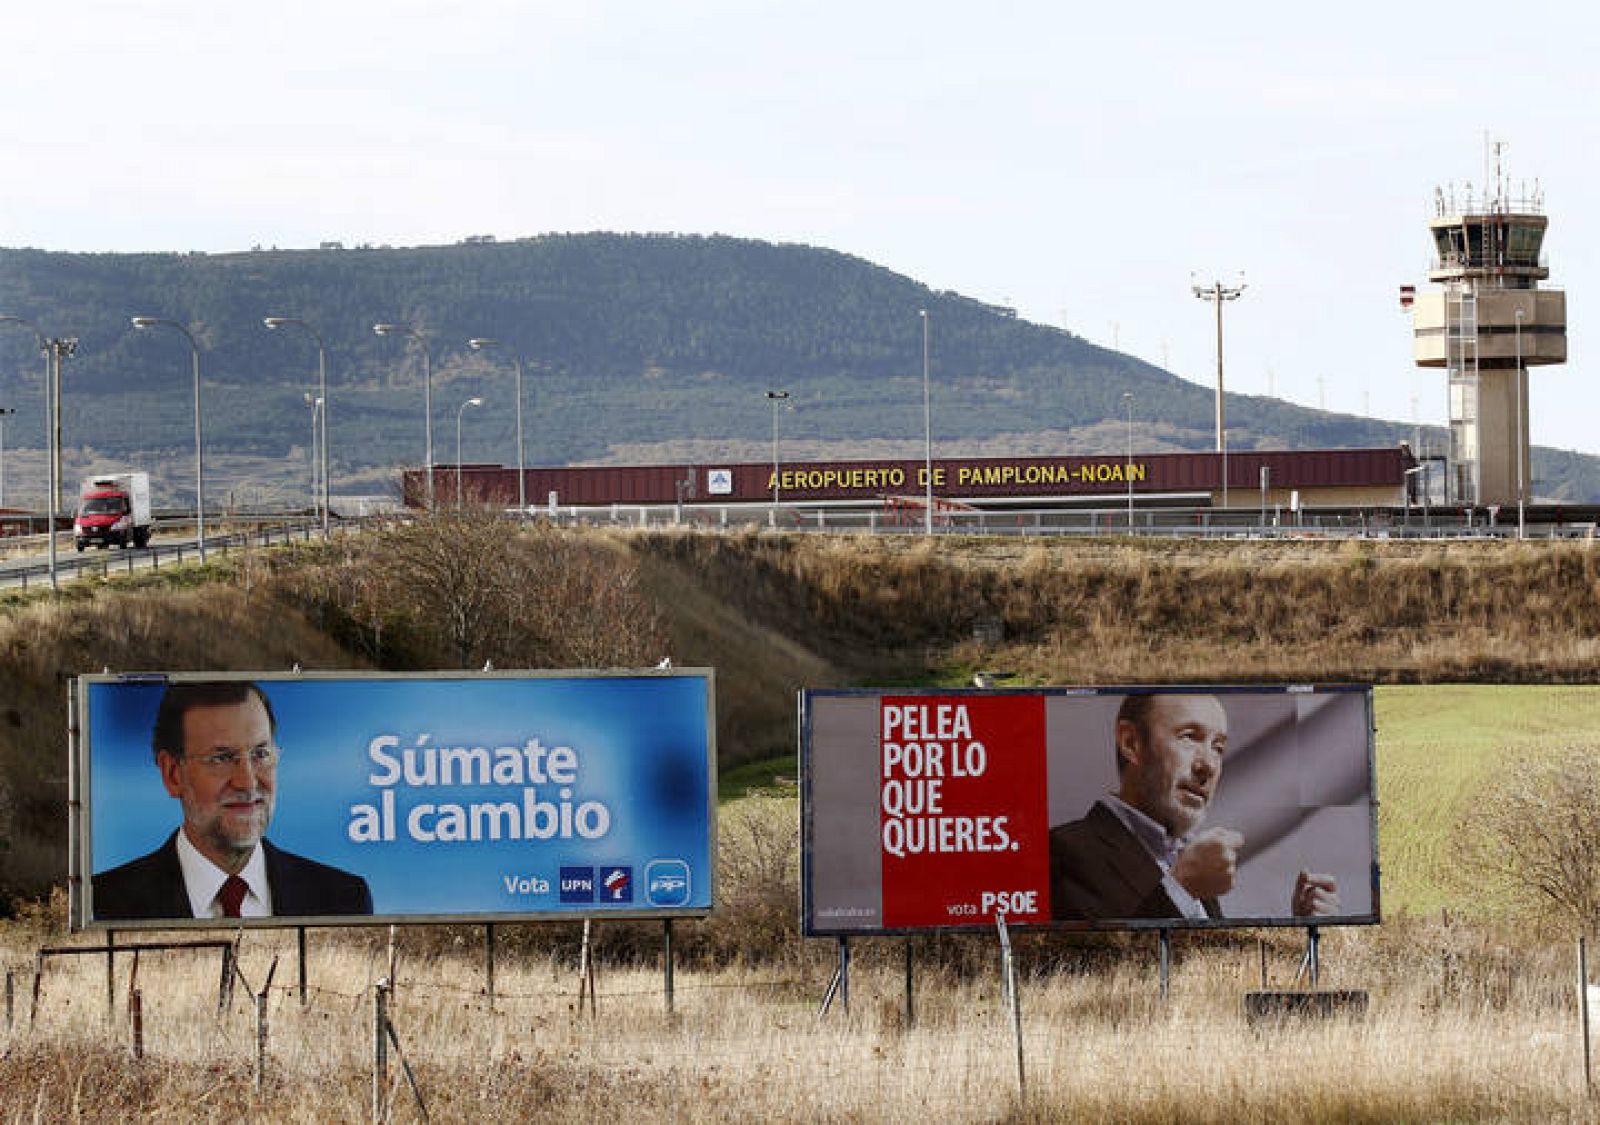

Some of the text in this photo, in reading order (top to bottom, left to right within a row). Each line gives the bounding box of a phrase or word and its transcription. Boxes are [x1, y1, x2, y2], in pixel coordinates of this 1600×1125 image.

[768, 468, 905, 490] AEROPUERTO
[918, 468, 945, 487] DE
[883, 705, 972, 740] PELEA
[369, 735, 578, 786] Súmate
[883, 742, 988, 777] POR LO
[348, 787, 611, 842] al cambio
[882, 780, 943, 819] QUE
[882, 816, 1019, 859] QUIERES.
[503, 876, 592, 895] Vota UPN
[946, 891, 1038, 916] vota PSOE
